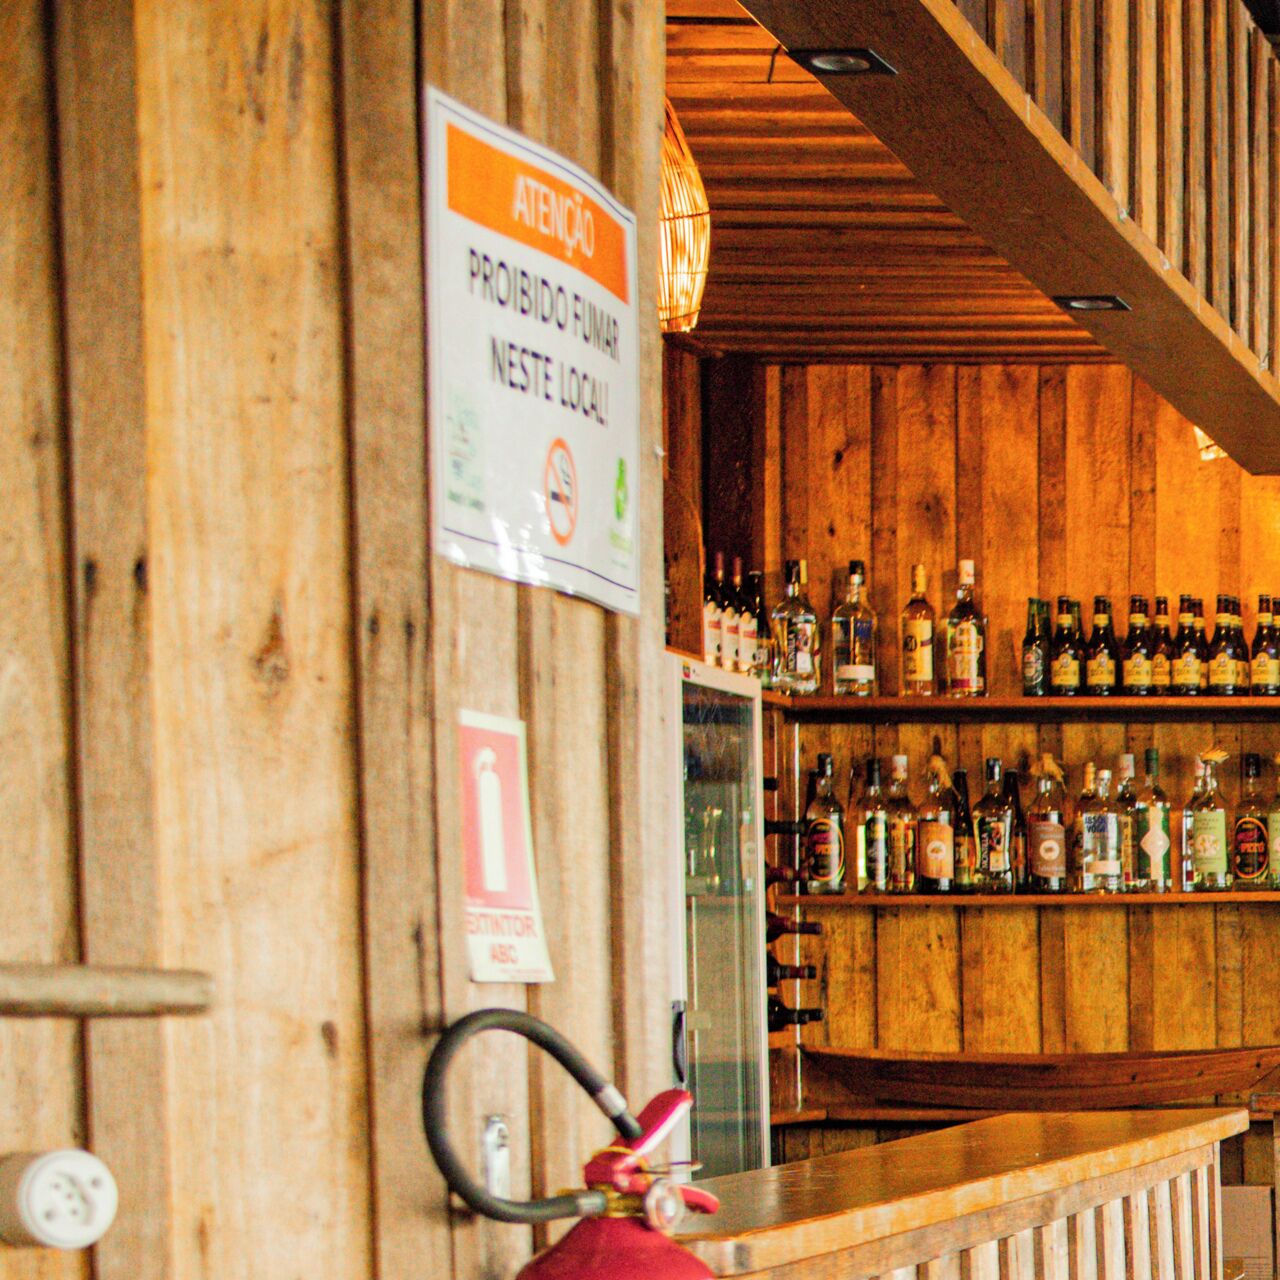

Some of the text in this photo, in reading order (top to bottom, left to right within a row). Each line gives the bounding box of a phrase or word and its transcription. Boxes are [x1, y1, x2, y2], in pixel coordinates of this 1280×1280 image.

[513, 175, 594, 259] ATENÇÃO
[469, 248, 620, 363] PROIBIDO FUMAR
[490, 335, 609, 427] NESTE LOCAL!
[464, 911, 538, 938] EXTINTOR
[490, 943, 518, 964] ABC
